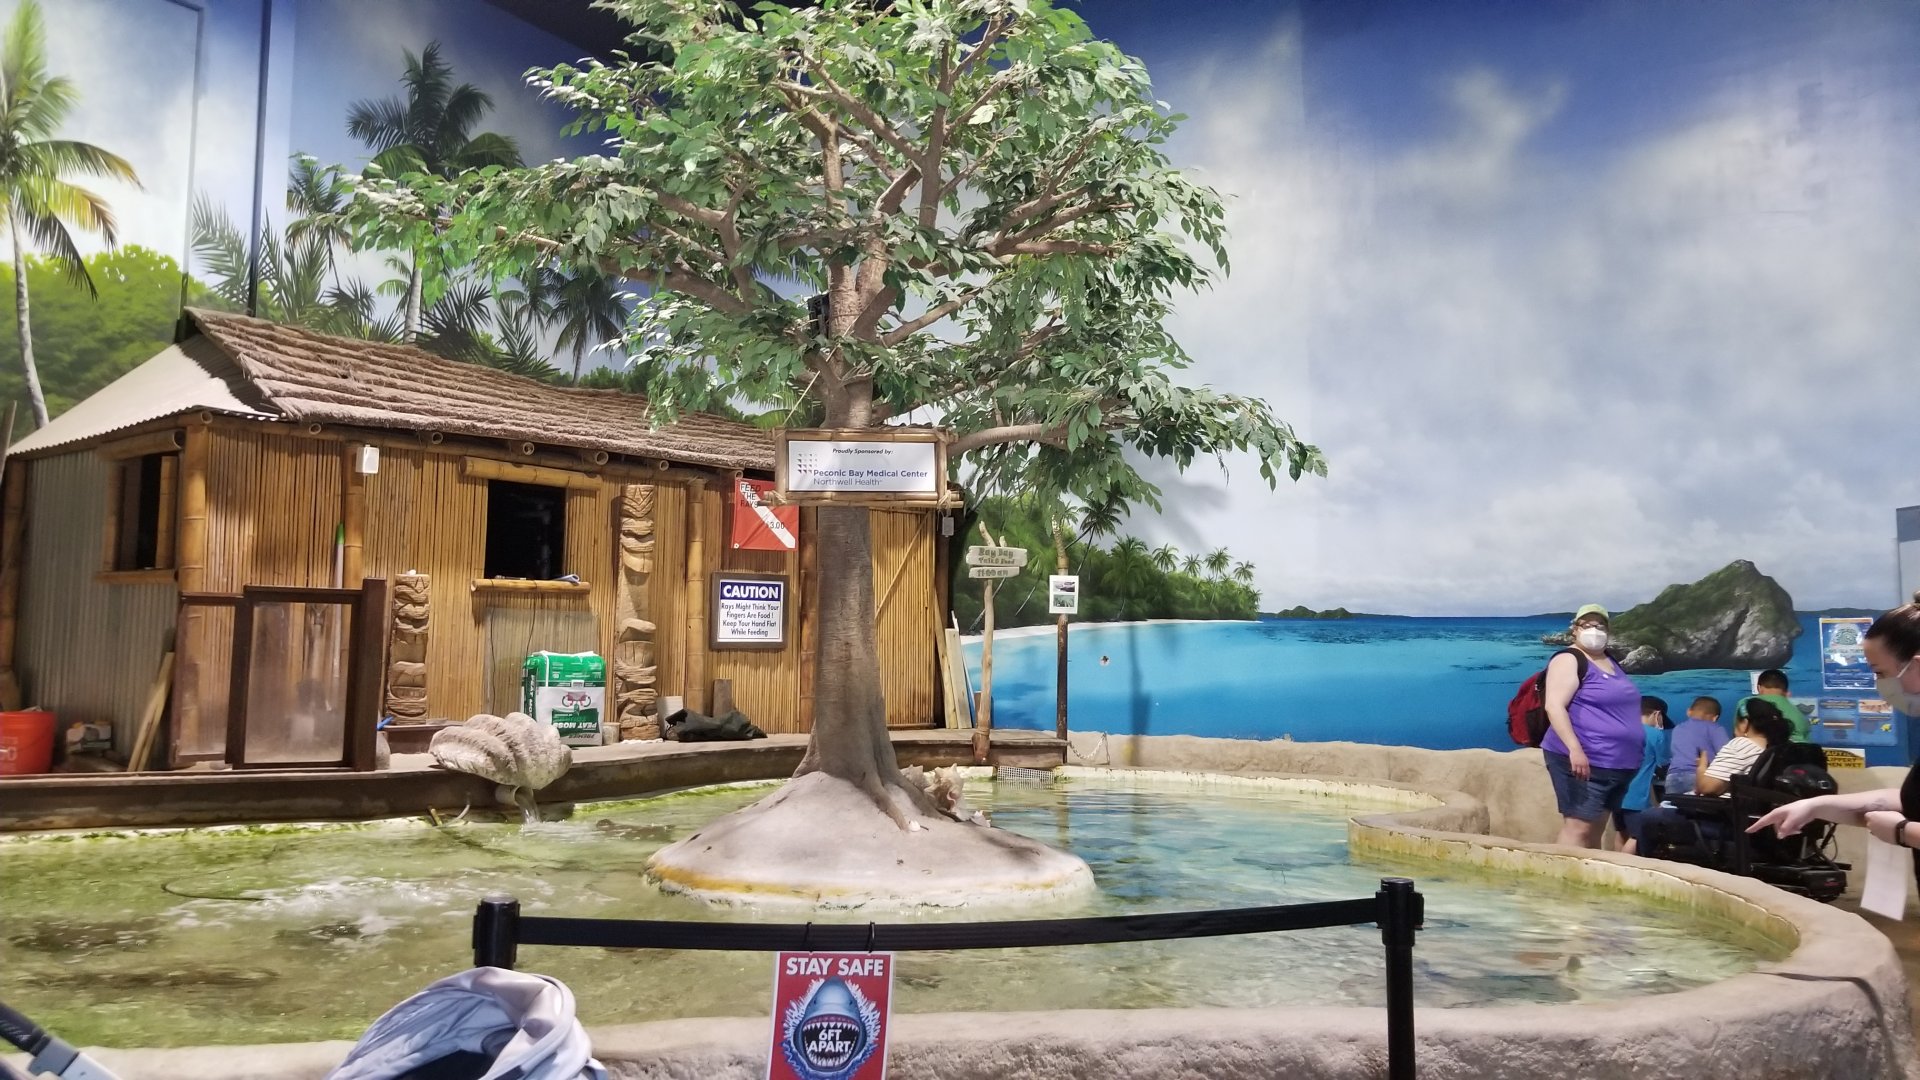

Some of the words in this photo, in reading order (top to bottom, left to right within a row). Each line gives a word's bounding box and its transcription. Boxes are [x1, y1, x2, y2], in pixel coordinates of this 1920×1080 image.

[813, 469, 846, 477] Peconic
[848, 469, 864, 478] Bay
[866, 470, 898, 478] Medical
[900, 470, 928, 478] Center
[813, 478, 853, 486] Northwell
[855, 478, 880, 486] Health
[740, 483, 762, 493] FEED
[743, 491, 756, 501] THE
[723, 584, 779, 599] CAUTION
[721, 602, 735, 611] Rays
[735, 603, 751, 611] Might
[752, 603, 766, 611] Think
[767, 603, 779, 611] Your
[726, 611, 746, 619] Fingers
[722, 620, 737, 628] Keep
[751, 620, 766, 628] Hand
[766, 620, 777, 628] Flat
[731, 628, 747, 636] While
[747, 629, 769, 637] Feeding
[786, 957, 833, 976] STAY
[837, 958, 884, 976] SAFE
[818, 1029, 842, 1041] 6FT
[808, 1041, 851, 1052] APART
